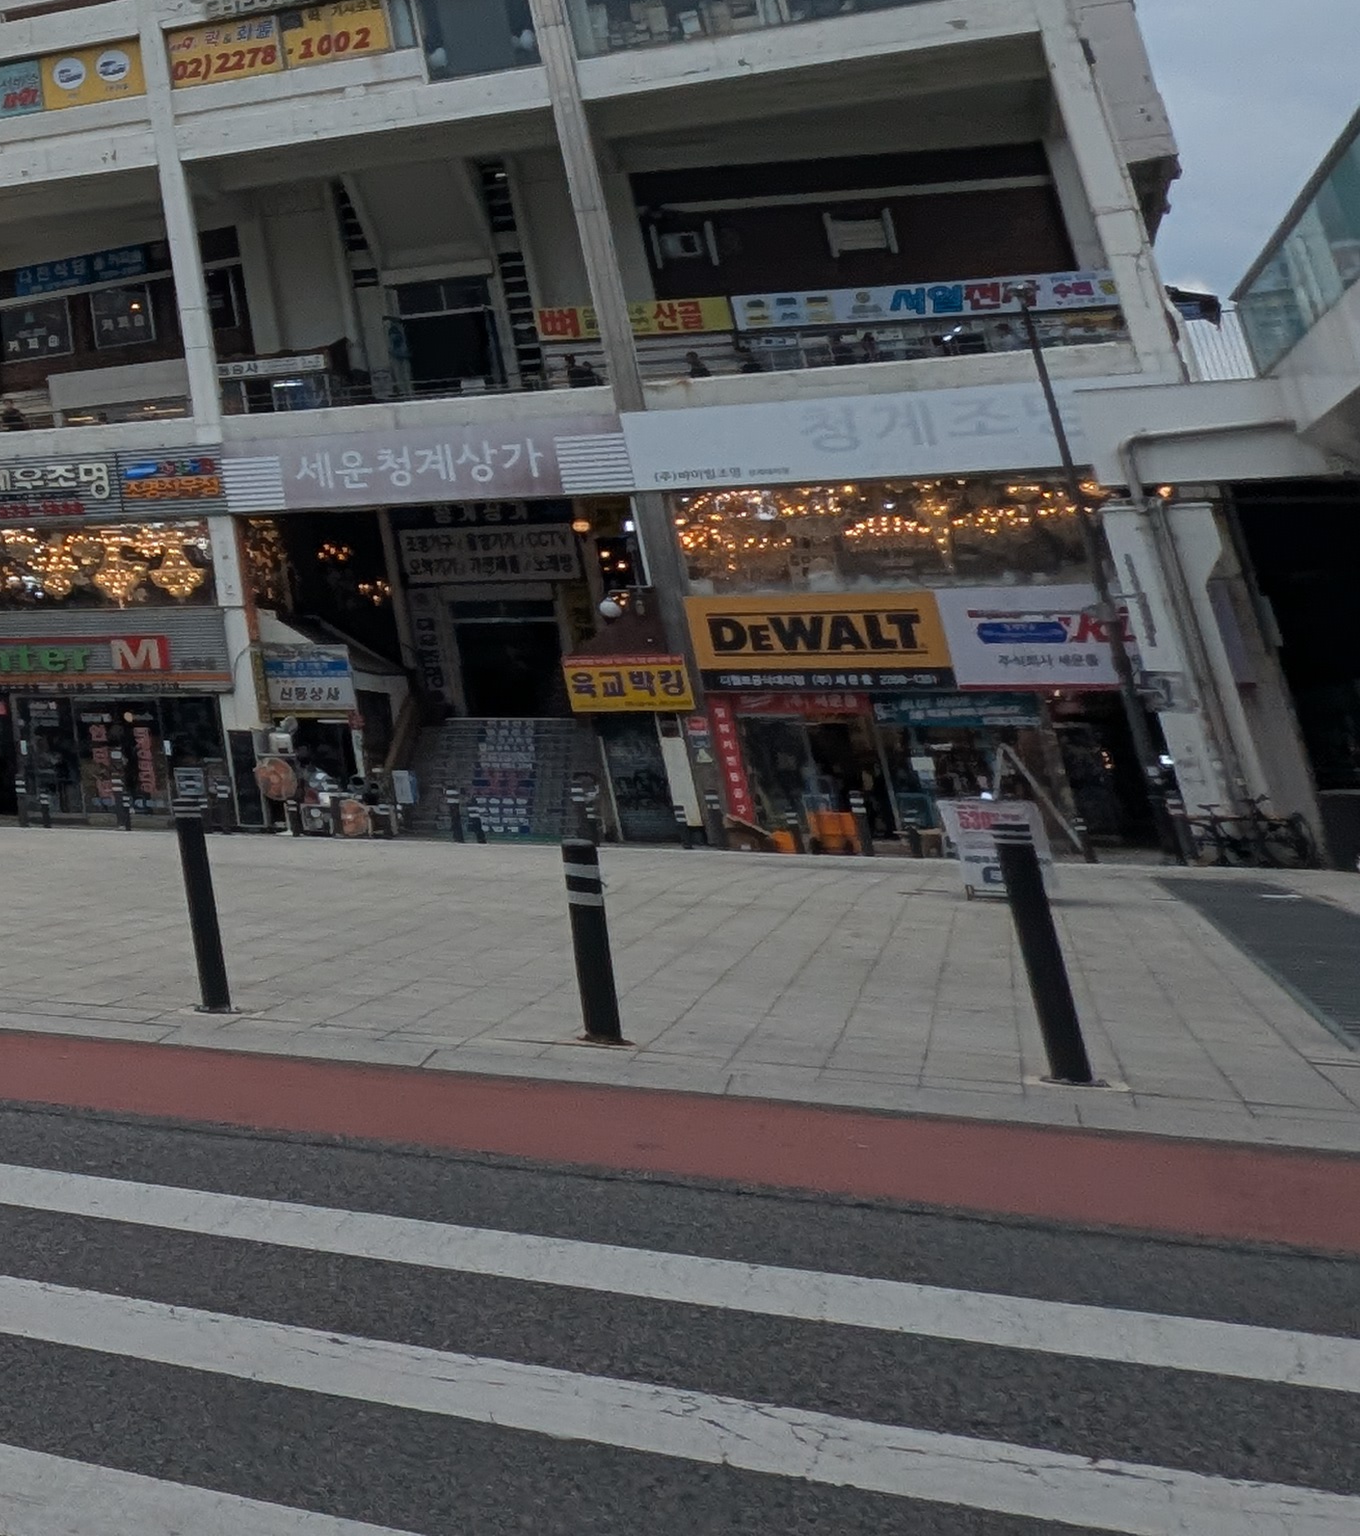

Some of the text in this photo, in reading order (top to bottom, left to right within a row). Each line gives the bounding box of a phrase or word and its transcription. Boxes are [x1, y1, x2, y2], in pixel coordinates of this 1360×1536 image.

[295, 438, 544, 491] 세운청계상가
[111, 638, 162, 670] M
[571, 669, 685, 698] 육교박킹
